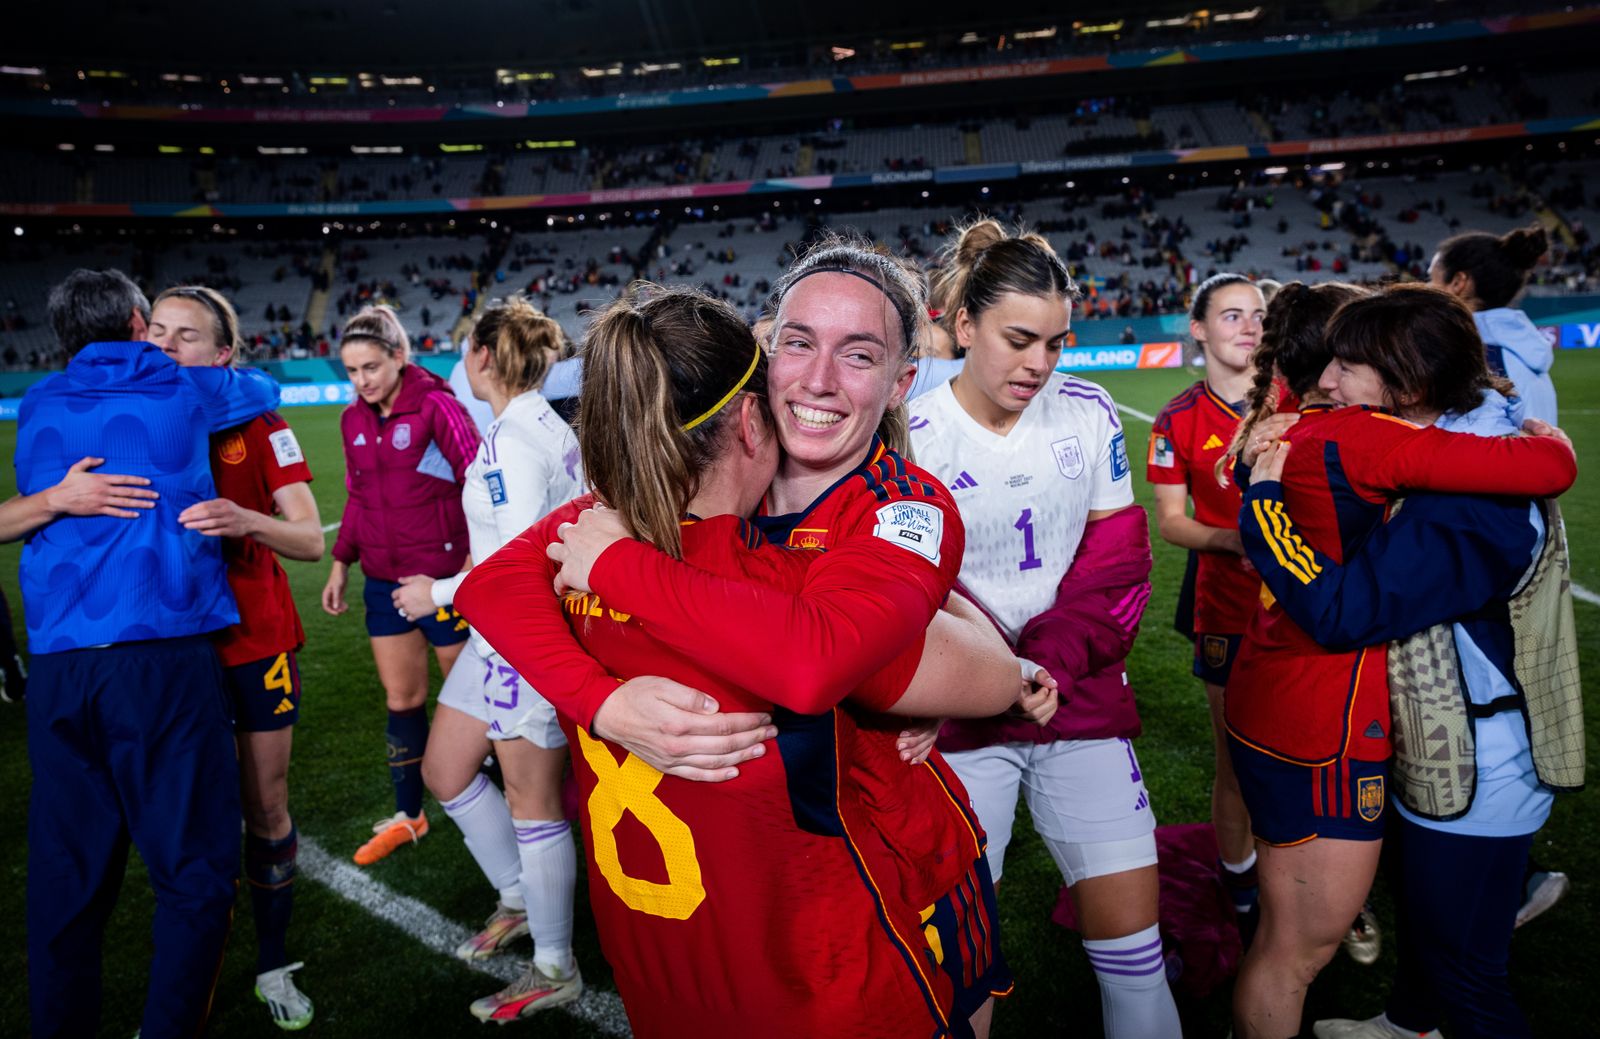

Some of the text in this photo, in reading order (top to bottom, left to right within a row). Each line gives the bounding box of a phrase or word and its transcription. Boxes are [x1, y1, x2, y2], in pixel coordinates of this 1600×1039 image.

[900, 530, 921, 542] FIFA
[1014, 508, 1042, 571] 1
[264, 652, 293, 694] 4
[577, 724, 706, 921] 8
